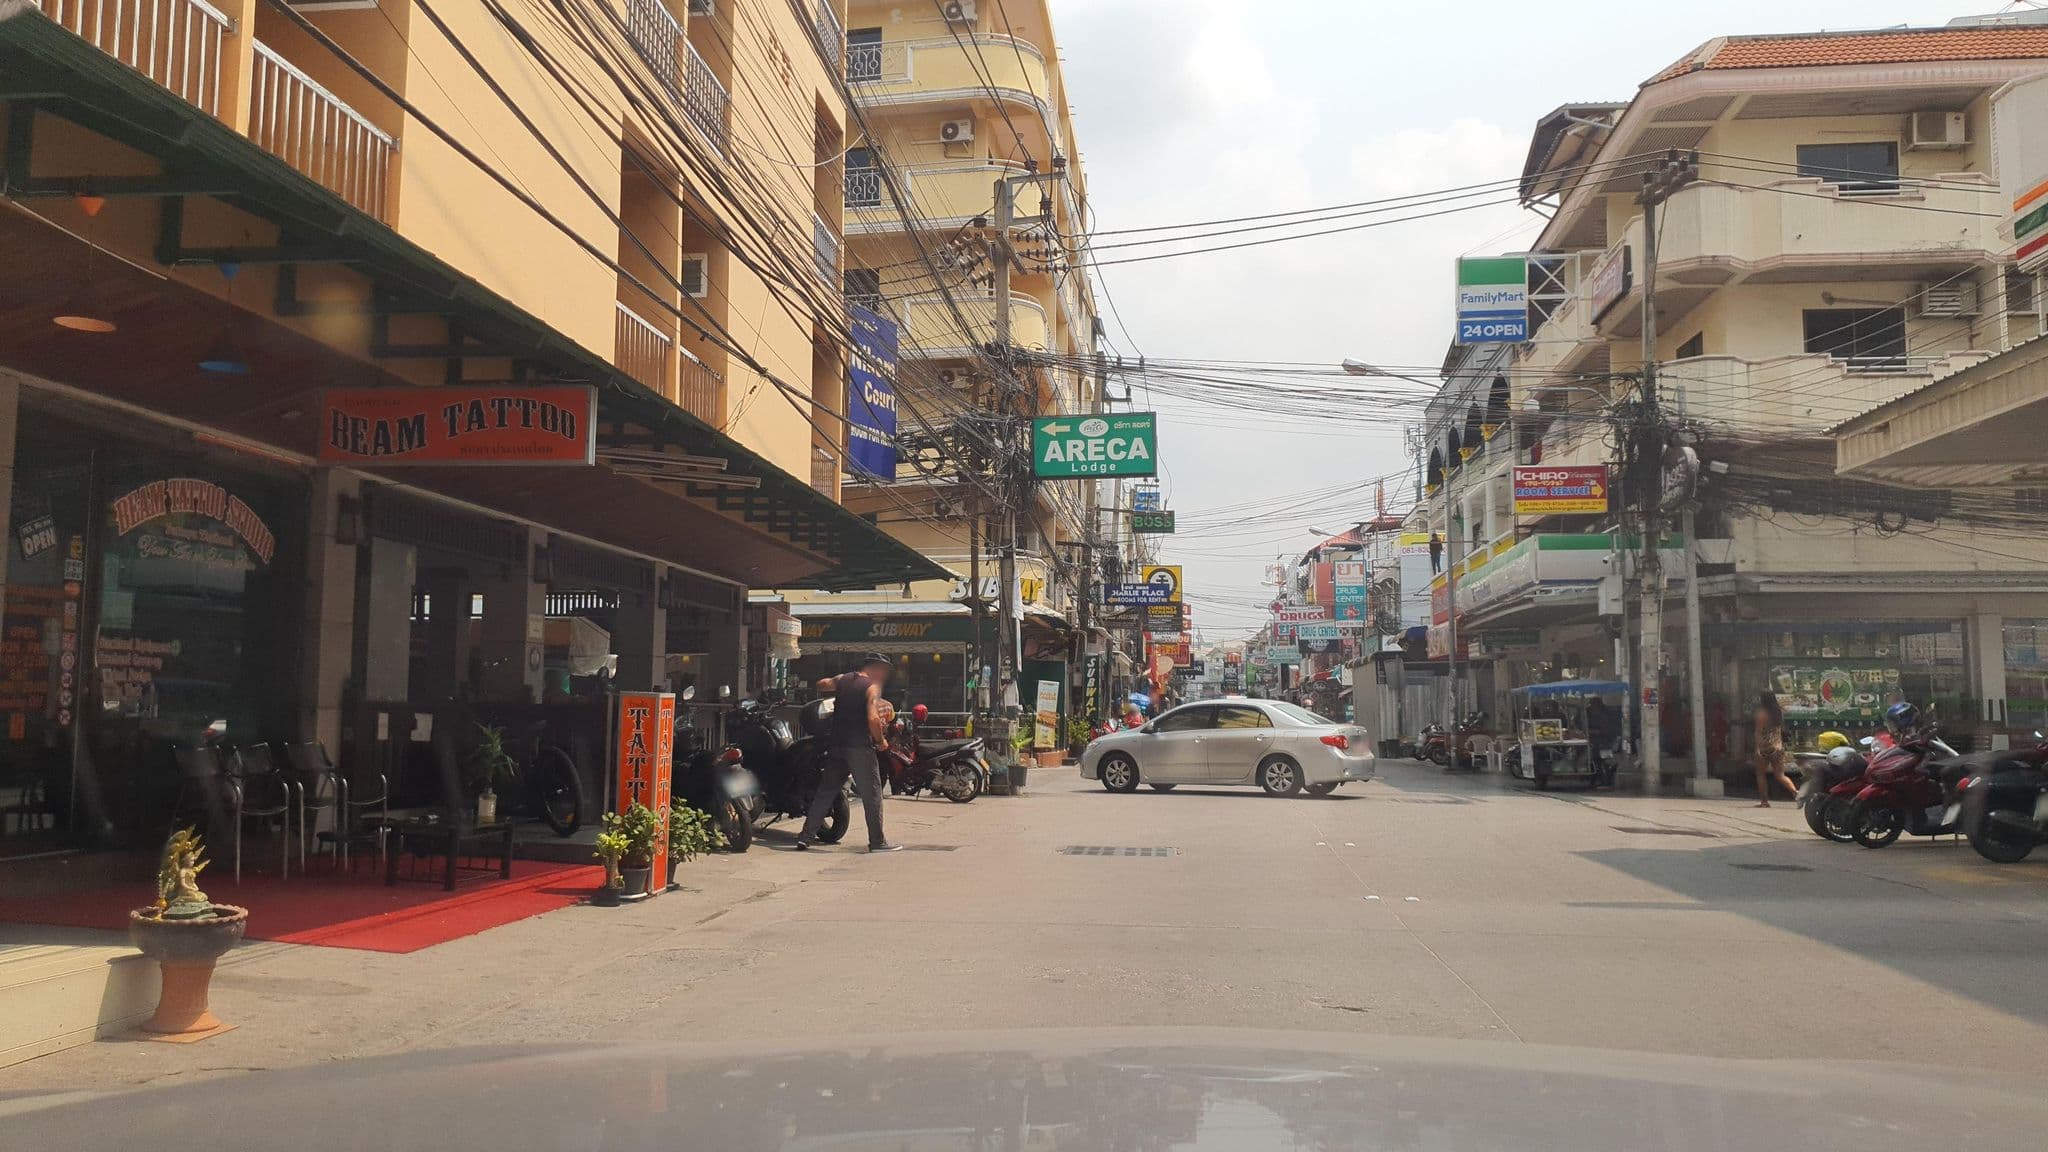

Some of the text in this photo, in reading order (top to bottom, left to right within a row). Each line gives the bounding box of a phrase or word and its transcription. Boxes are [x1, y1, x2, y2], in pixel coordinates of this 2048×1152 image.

[1461, 292, 1525, 305] FamilyMart
[1464, 324, 1523, 337] 24 OPEN
[865, 380, 896, 412] Court
[329, 397, 577, 457] BEAM TATTOO
[1043, 438, 1150, 462] ARECA
[1072, 463, 1117, 473] Lodge
[1516, 471, 1568, 481] ICHIRO
[1516, 486, 1590, 497] ROOM SERVICE
[24, 528, 57, 556] OPEN
[1336, 587, 1358, 595] DRUG
[1280, 612, 1325, 621] DRUGS
[868, 622, 928, 638] SUBWAY
[1086, 658, 1097, 717] SUBWAY
